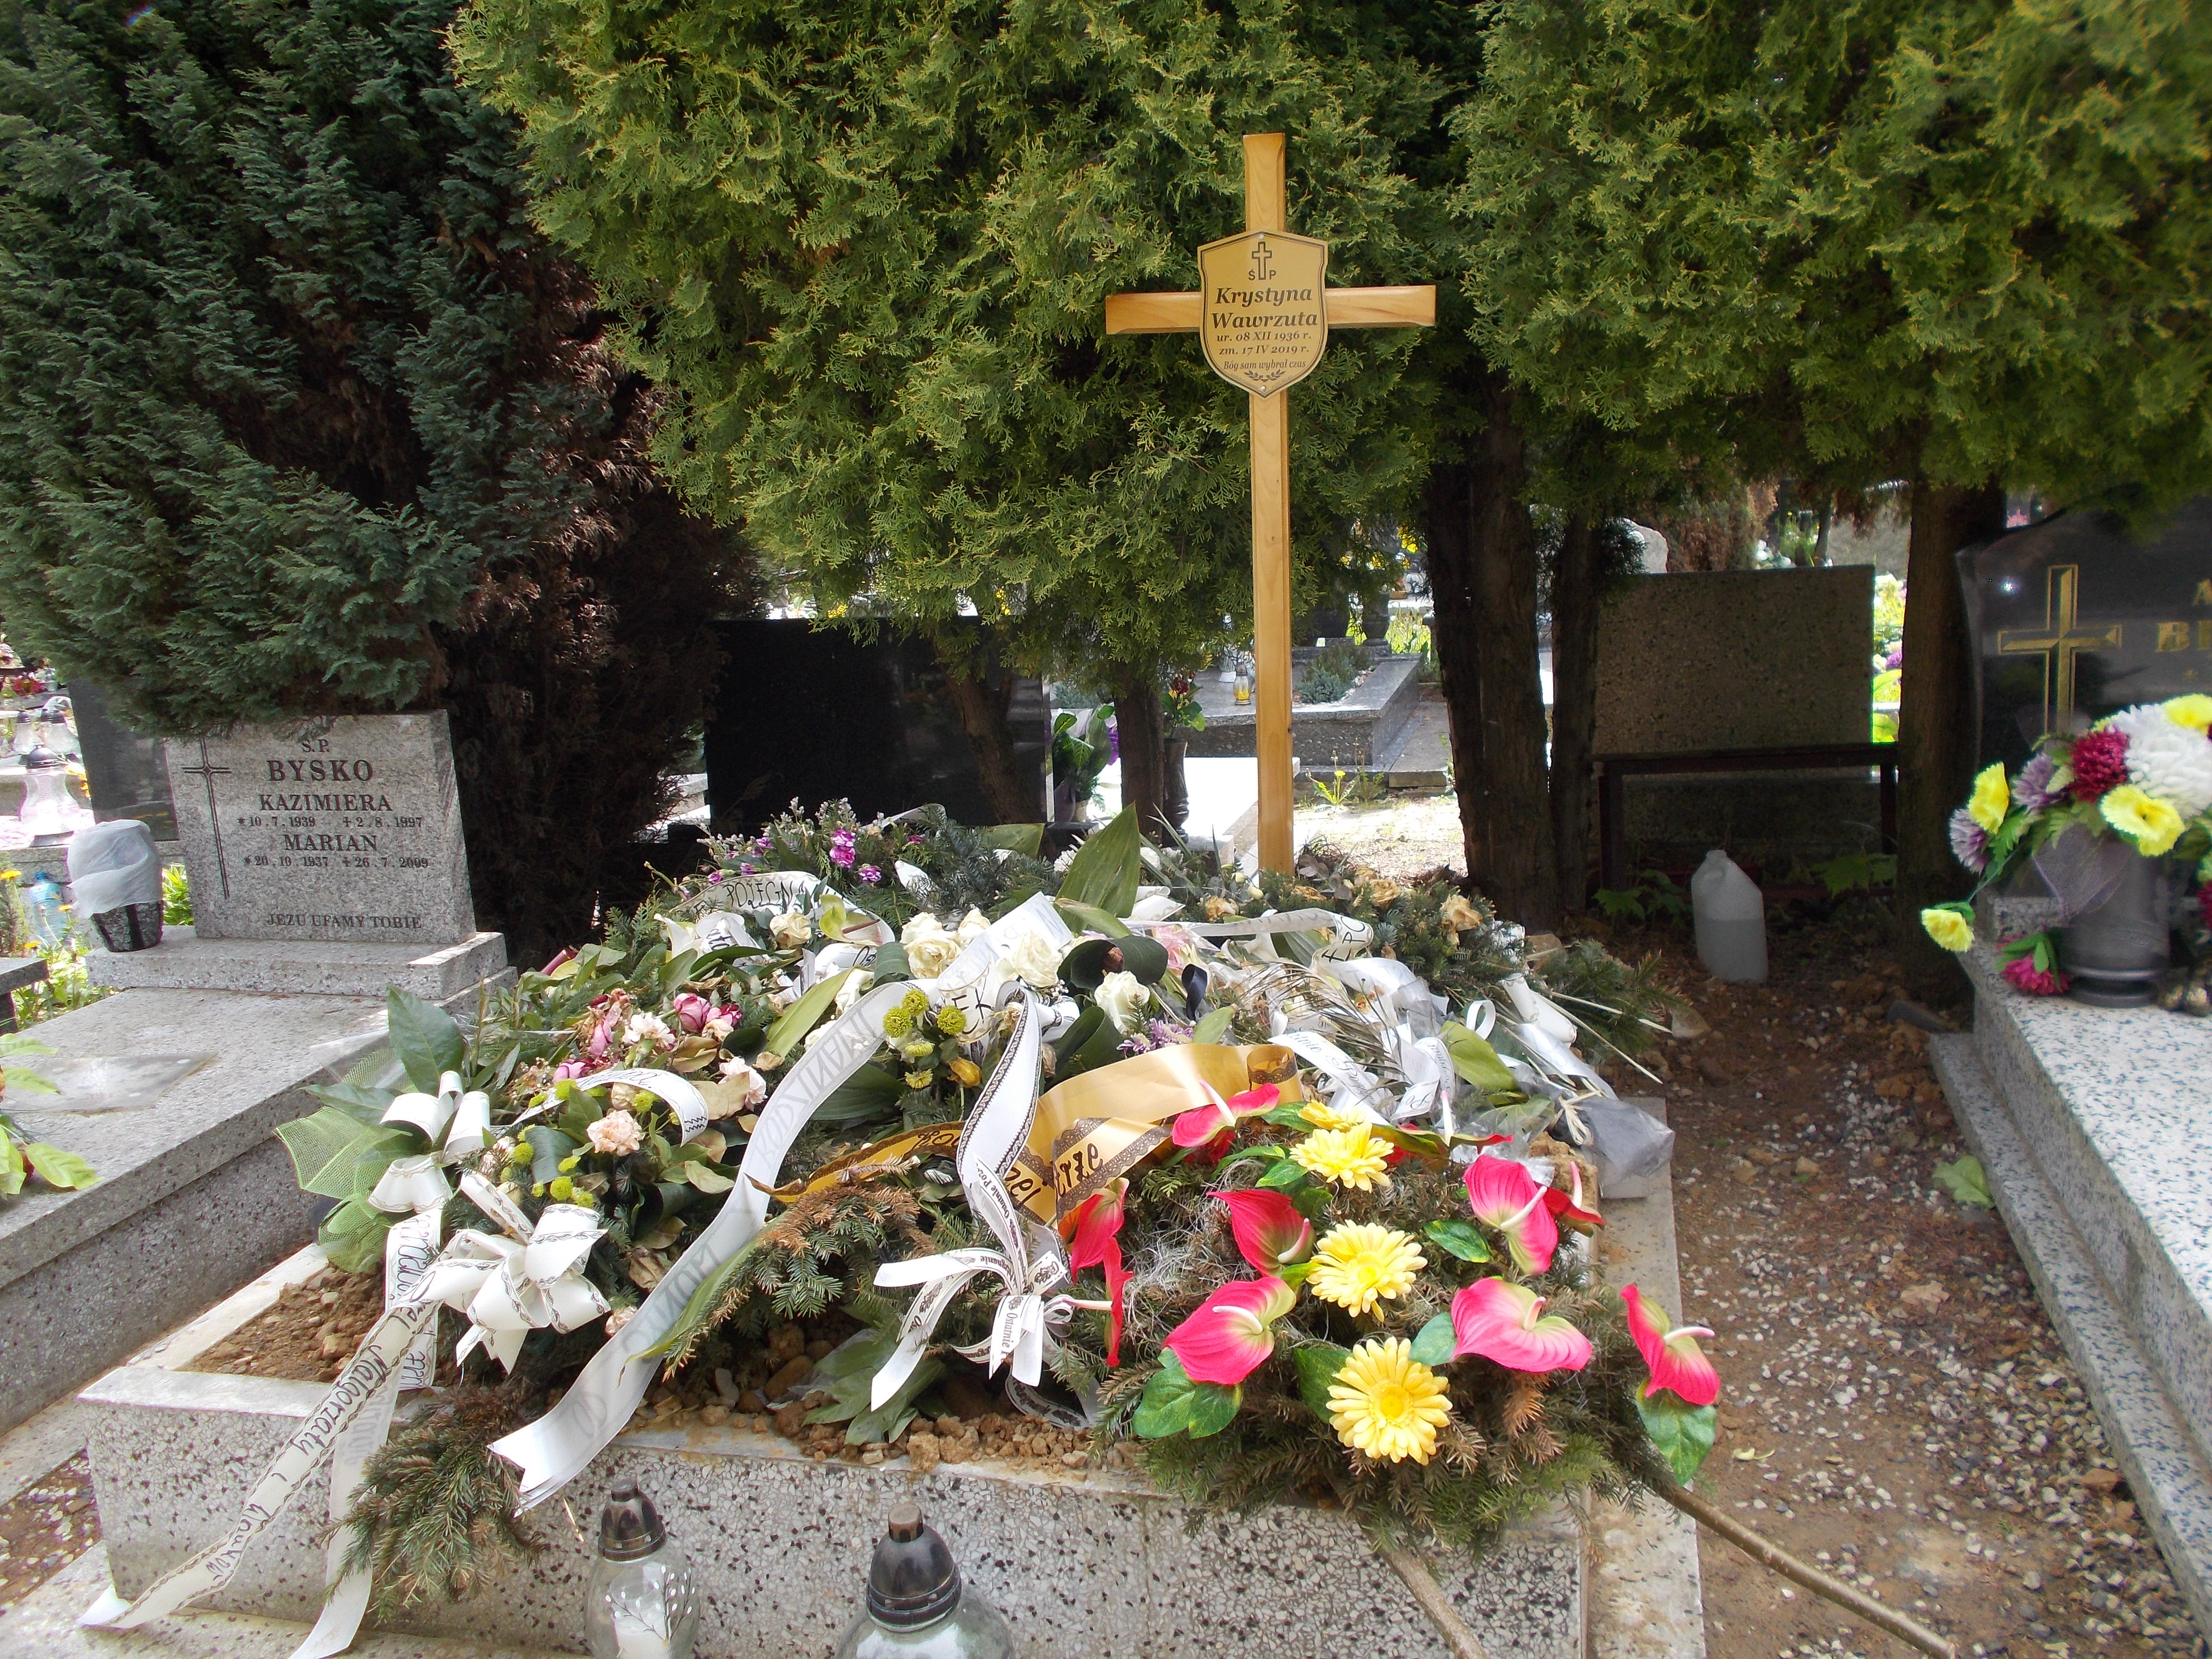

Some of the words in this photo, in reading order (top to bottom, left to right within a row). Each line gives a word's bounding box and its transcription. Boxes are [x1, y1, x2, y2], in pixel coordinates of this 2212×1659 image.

[1215, 288, 1312, 307] Krystyna
[1212, 312, 1318, 329] Wawrzuta
[1236, 332, 1250, 341] 08
[1252, 331, 1271, 340] XII
[1274, 331, 1300, 341] 1936
[1242, 347, 1253, 356] 17
[1255, 345, 1269, 354] IV
[1271, 345, 1298, 354] 2019
[1224, 361, 1238, 371] Bóg
[266, 759, 373, 781] BYSKO
[258, 794, 393, 811] KAZIMIERA
[282, 834, 378, 852] MARIAN
[267, 913, 306, 926] JEZU
[312, 914, 364, 927] UFAMY
[371, 916, 422, 929] TOBIE
